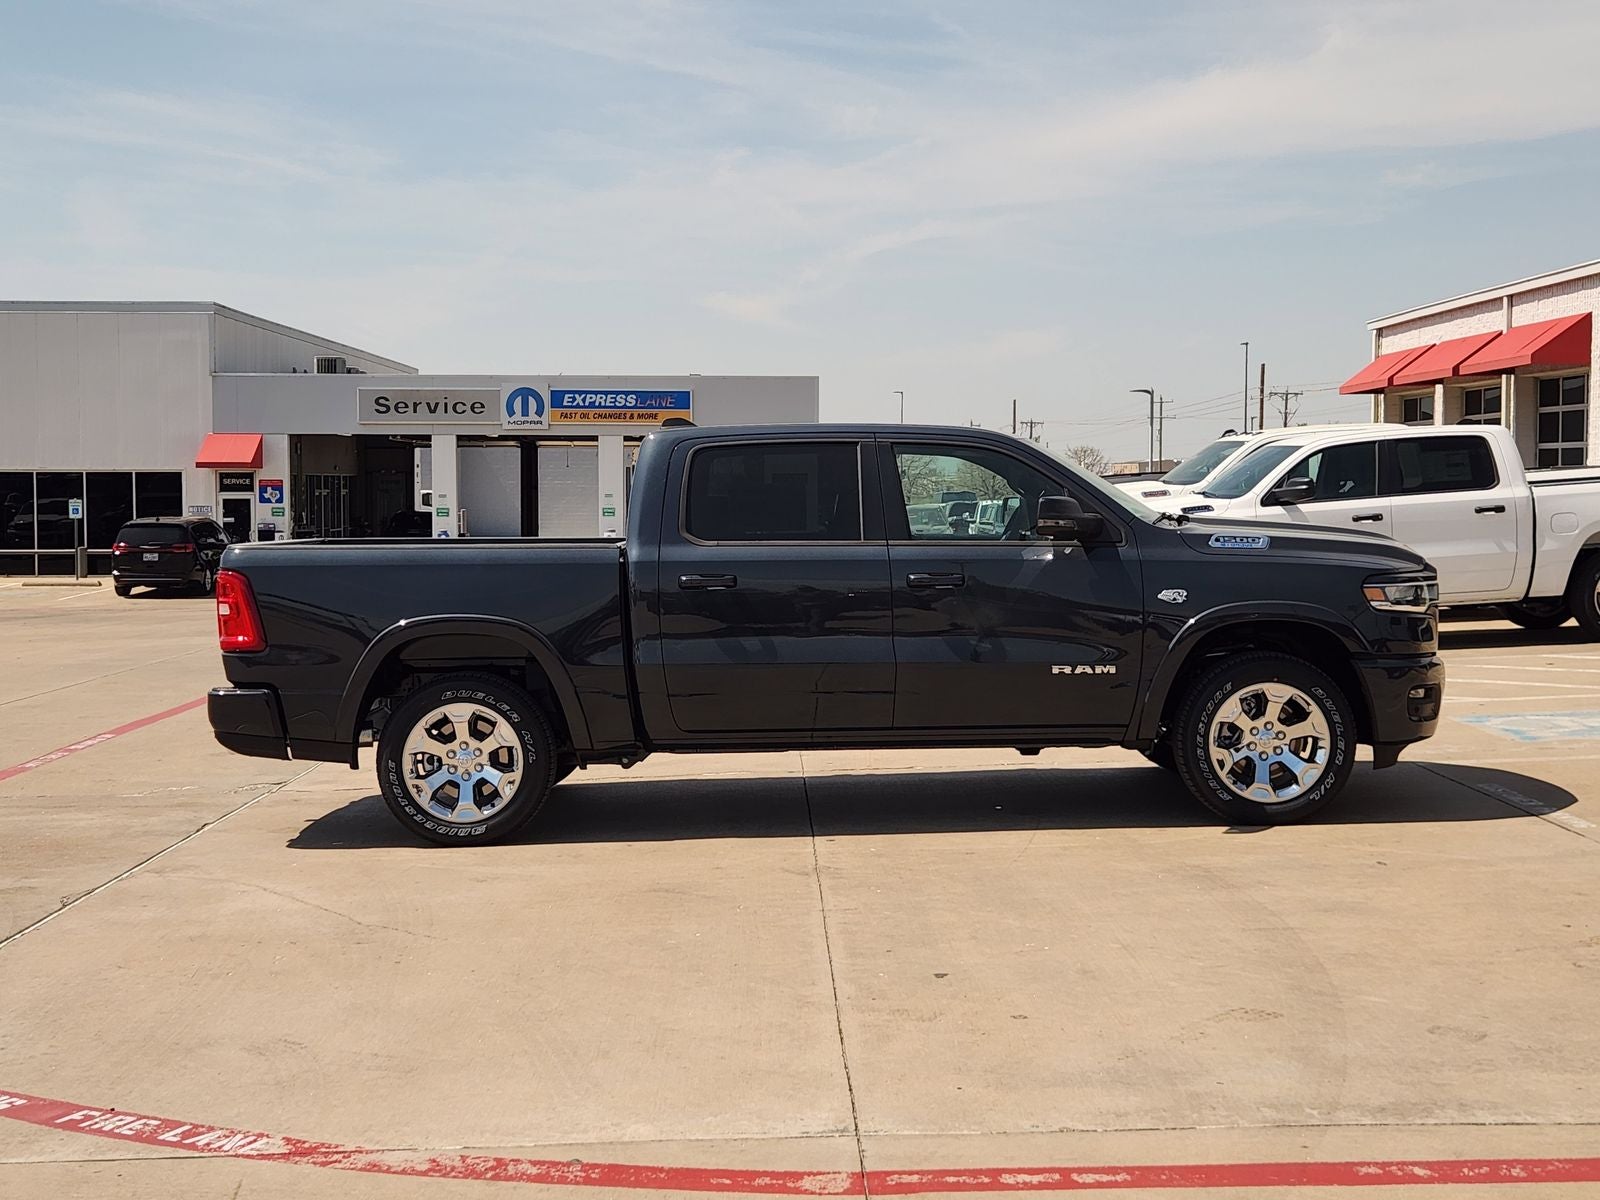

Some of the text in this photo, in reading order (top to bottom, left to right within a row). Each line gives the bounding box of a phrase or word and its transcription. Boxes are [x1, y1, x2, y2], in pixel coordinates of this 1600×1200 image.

[374, 396, 486, 414] Service
[560, 411, 660, 420] FAST OIL CHANGES & MORE
[1051, 664, 1116, 674] RAM
[441, 689, 521, 724] DUELER
[54, 1109, 162, 1136] FIRE
